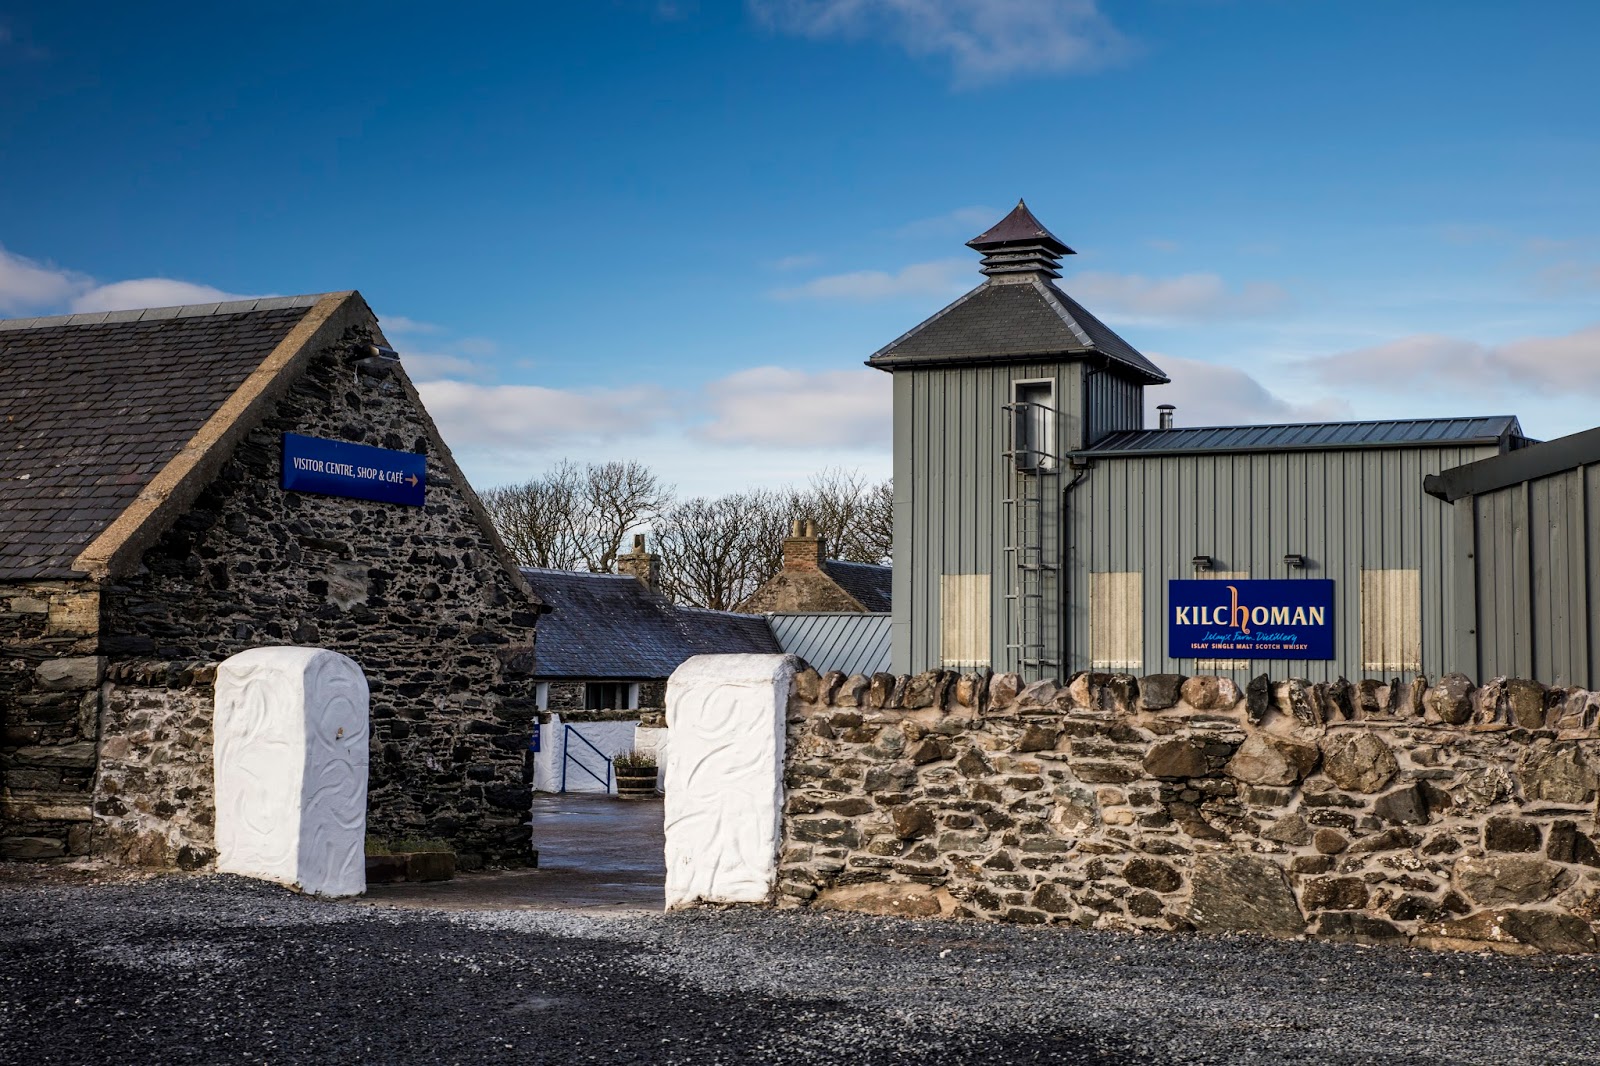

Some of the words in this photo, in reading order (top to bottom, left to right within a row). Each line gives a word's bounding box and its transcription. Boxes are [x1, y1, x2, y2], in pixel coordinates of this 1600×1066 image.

[293, 457, 324, 473] VISITOR
[325, 461, 356, 479] CENTRE,
[357, 466, 377, 480] SHOP
[378, 471, 385, 481] &
[386, 470, 404, 484] CAFÉ
[1233, 631, 1255, 642] Farm
[1256, 631, 1298, 646] Distillery
